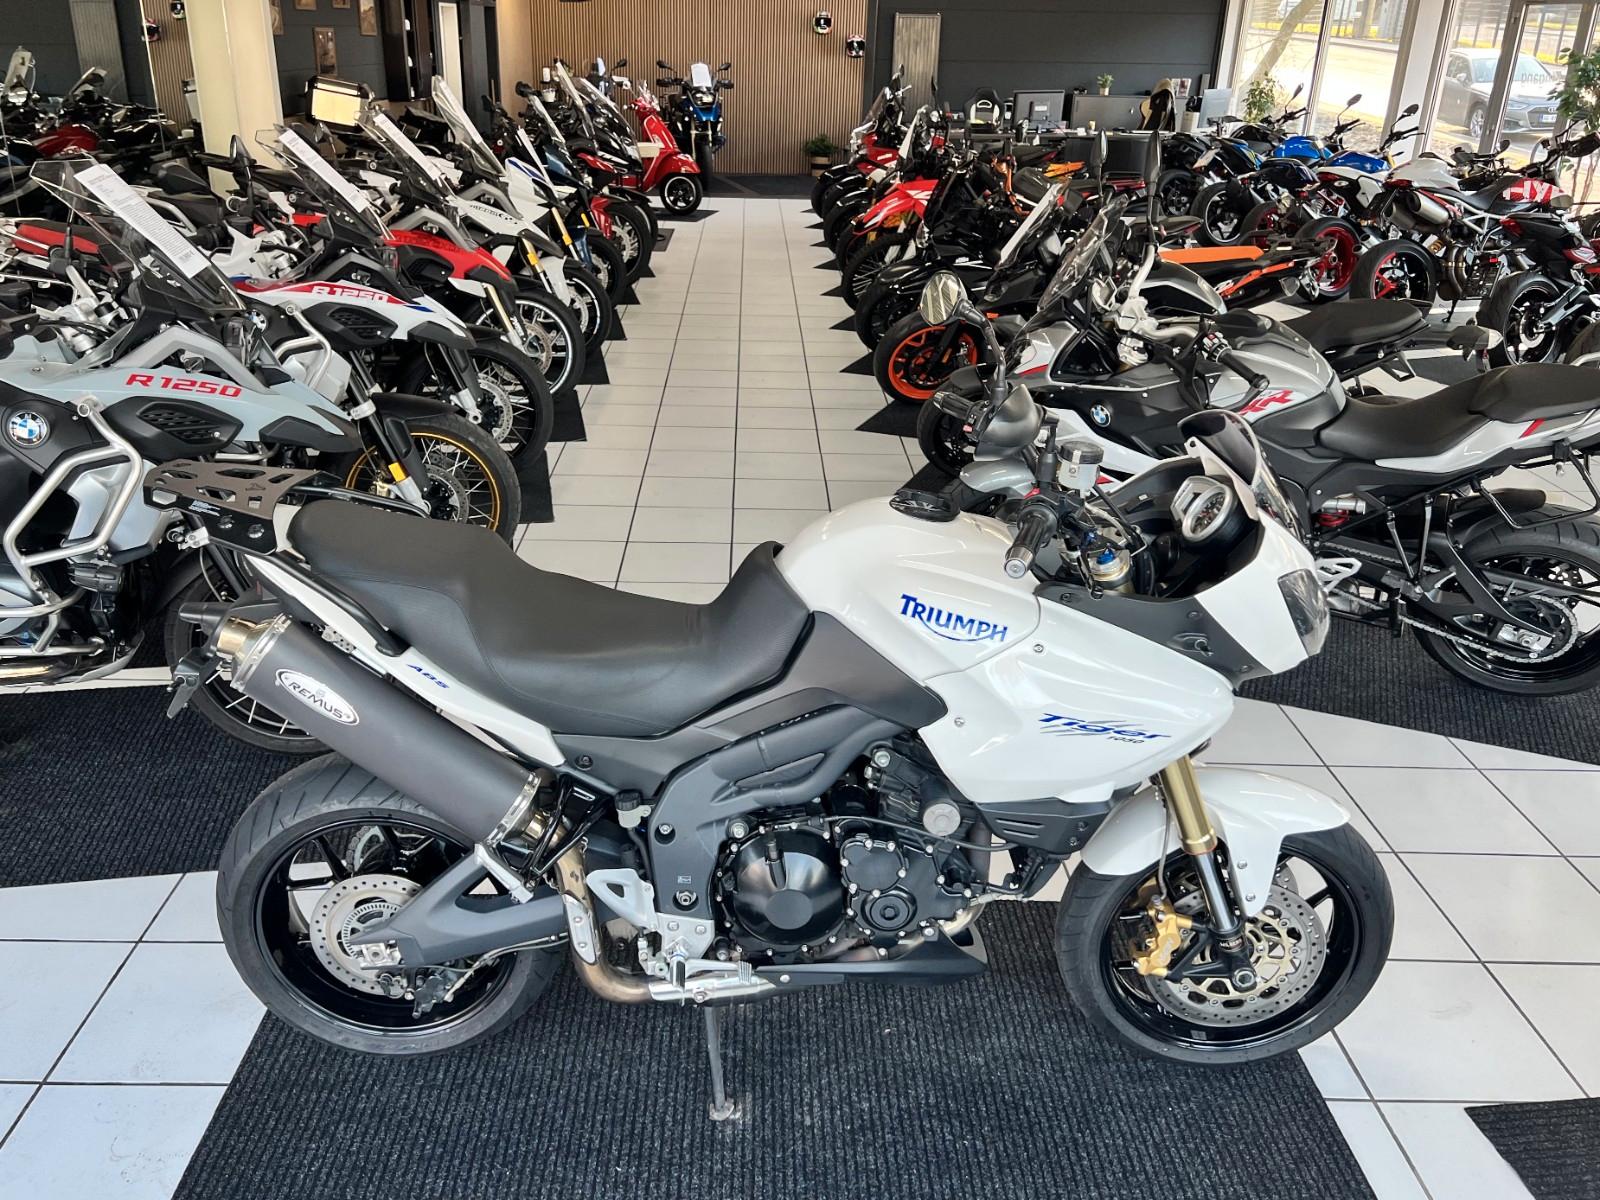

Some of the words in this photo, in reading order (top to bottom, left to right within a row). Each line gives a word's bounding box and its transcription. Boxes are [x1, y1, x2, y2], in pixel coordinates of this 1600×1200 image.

[126, 373, 155, 387] R
[160, 376, 242, 398] 1250
[900, 593, 1008, 642] TRIUMPH
[406, 664, 450, 689] ABS
[288, 681, 344, 719] REMUS
[1038, 712, 1171, 739] Tiger
